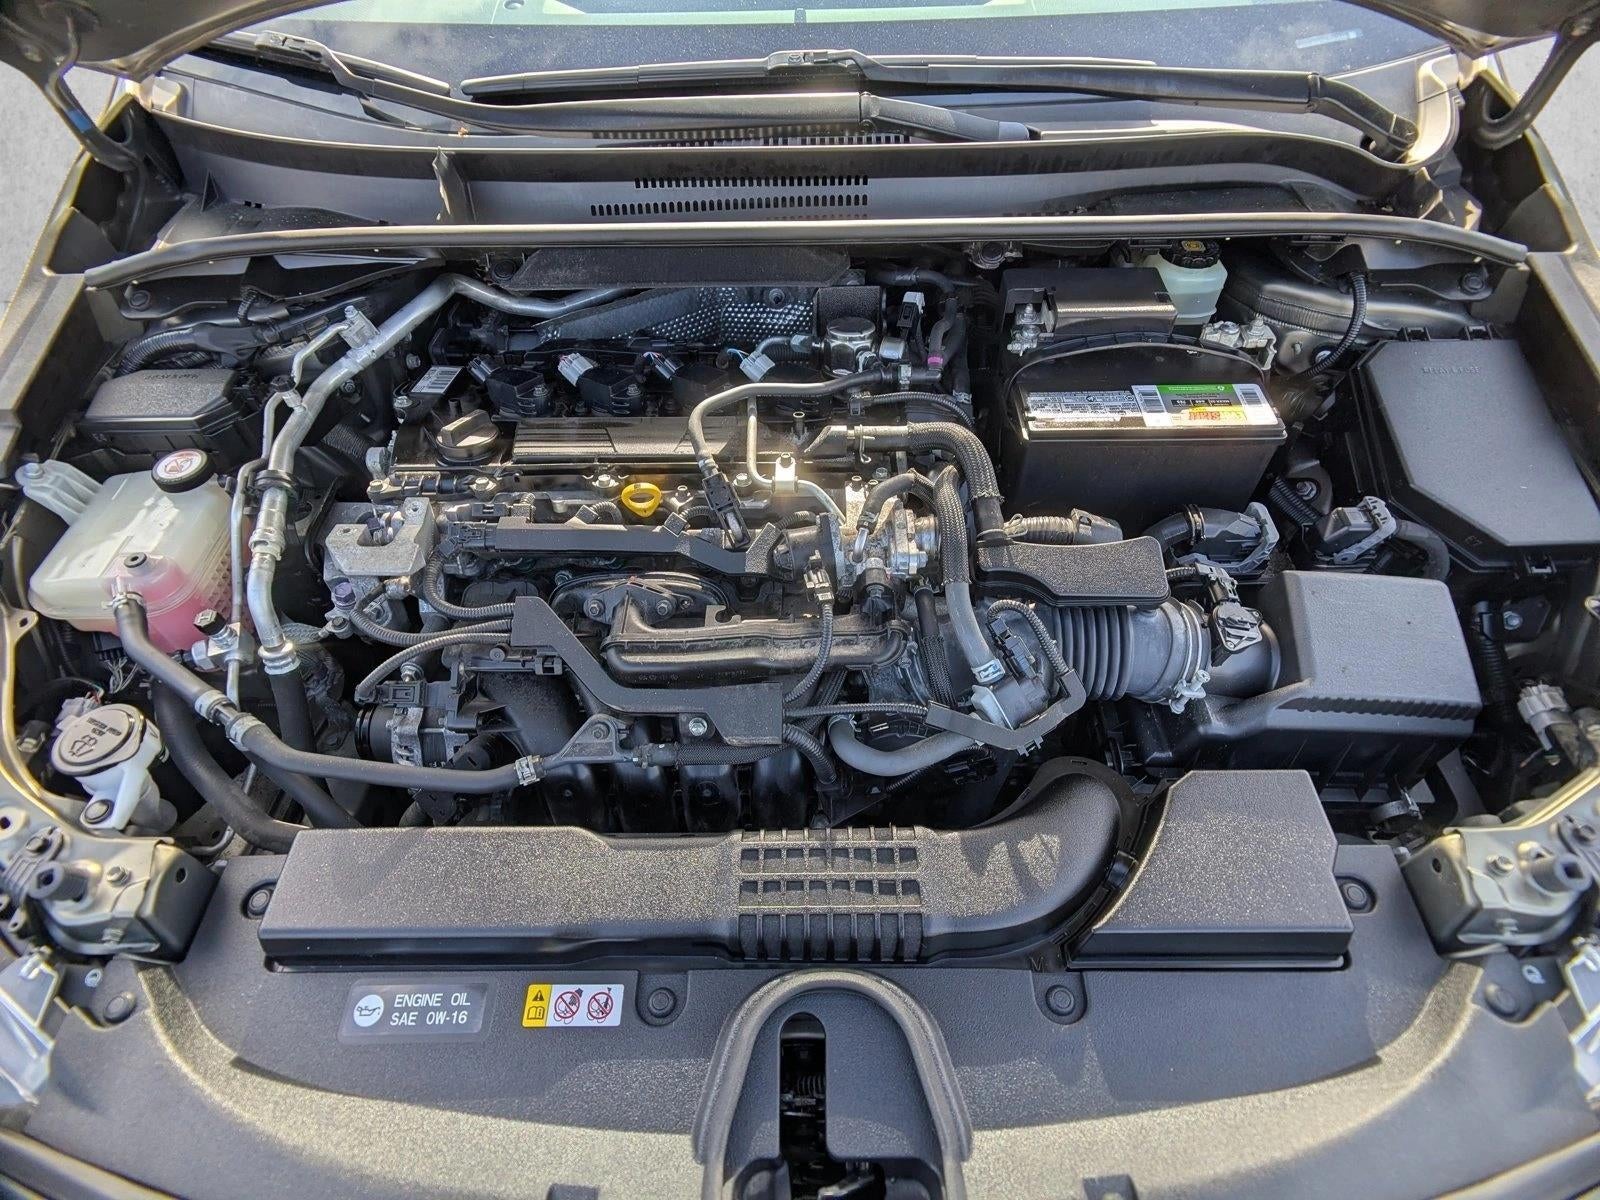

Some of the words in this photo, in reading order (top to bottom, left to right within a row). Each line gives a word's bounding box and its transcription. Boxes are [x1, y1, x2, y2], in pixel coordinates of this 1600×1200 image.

[394, 993, 443, 1007] ENGINE
[451, 992, 471, 1006] OIL
[390, 1011, 418, 1026] SAE
[426, 1010, 468, 1025] 0W-16
